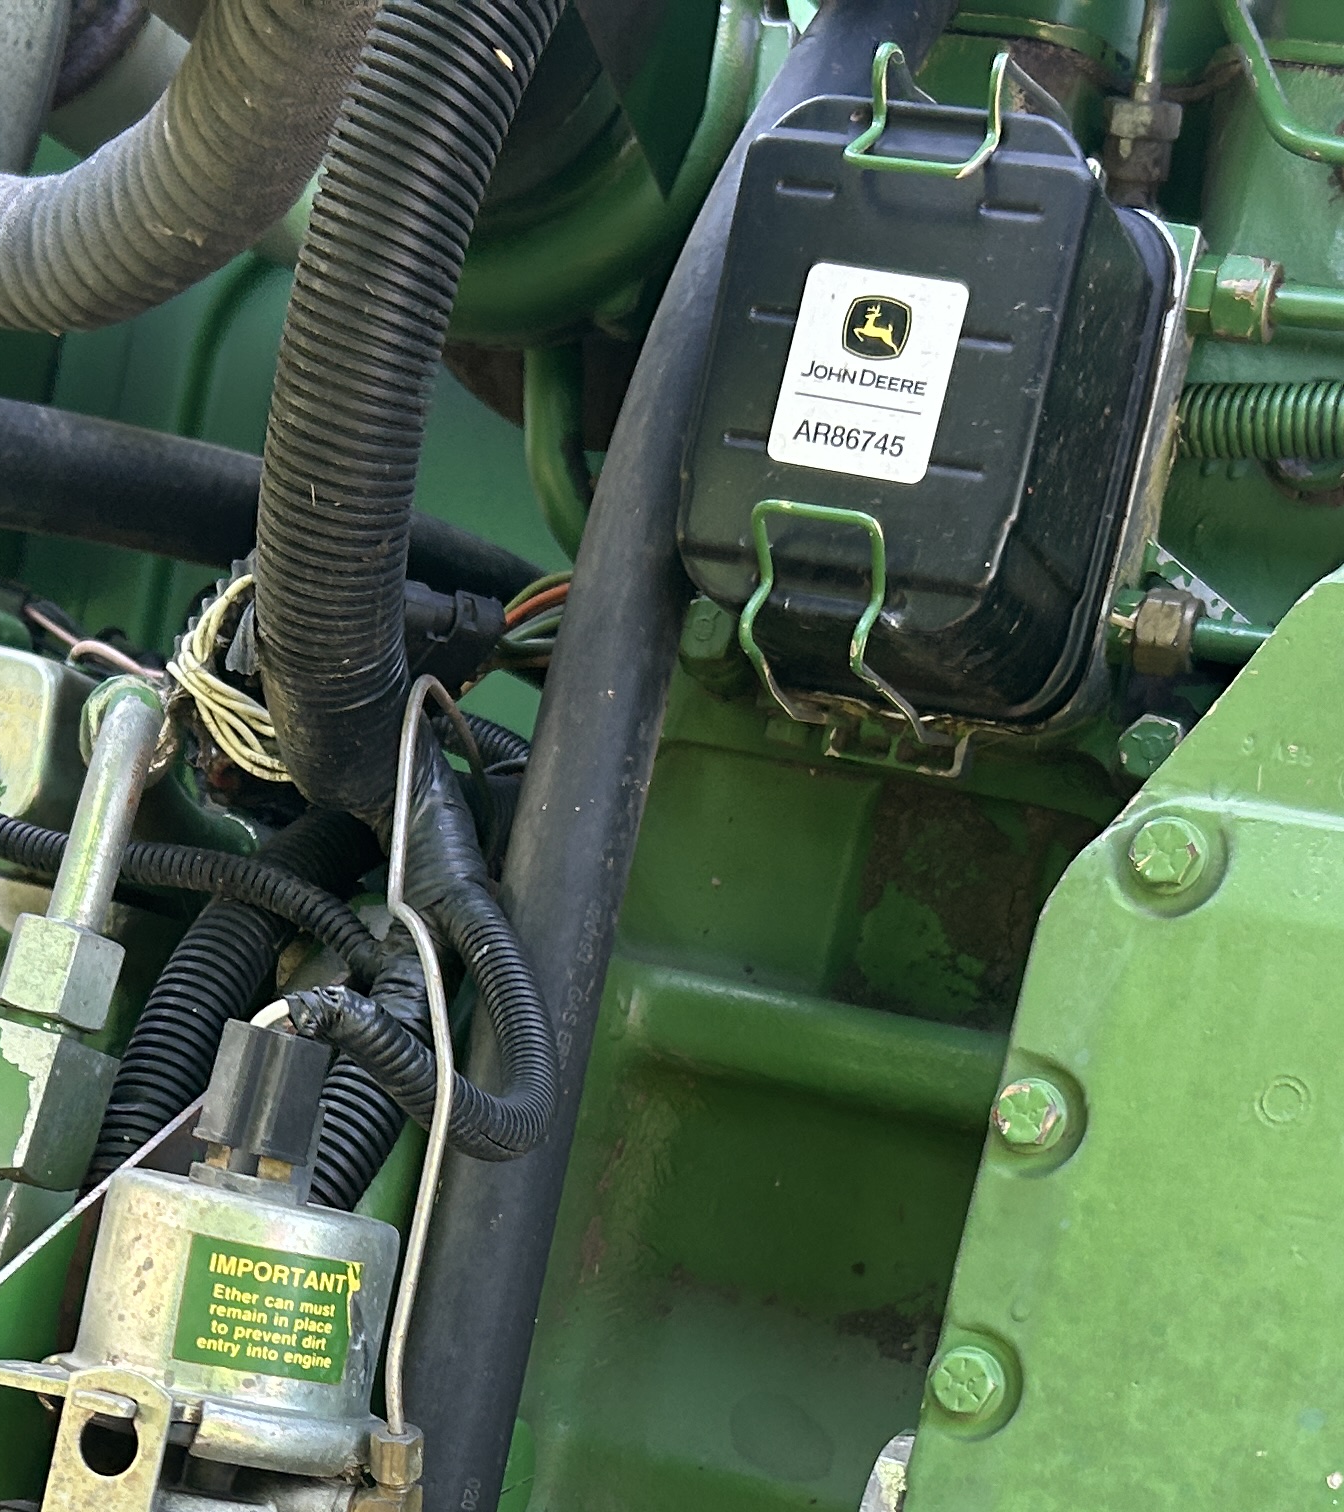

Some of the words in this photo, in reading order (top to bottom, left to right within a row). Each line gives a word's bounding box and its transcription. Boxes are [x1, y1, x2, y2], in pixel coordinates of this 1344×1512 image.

[801, 361, 856, 384] JOHN
[859, 369, 927, 396] DEERE
[792, 420, 905, 457] AR86745
[209, 1252, 347, 1294] IMPORTANT
[212, 1283, 259, 1305] Ether
[264, 1295, 294, 1311] can
[300, 1302, 336, 1317] must
[209, 1303, 268, 1324] remain
[273, 1312, 288, 1328] in
[294, 1317, 332, 1335] place
[211, 1319, 228, 1335] to
[233, 1326, 297, 1347] prevent
[301, 1334, 326, 1351] dirt
[196, 1337, 240, 1358] entry
[246, 1342, 278, 1361] into
[283, 1350, 332, 1370] engine
